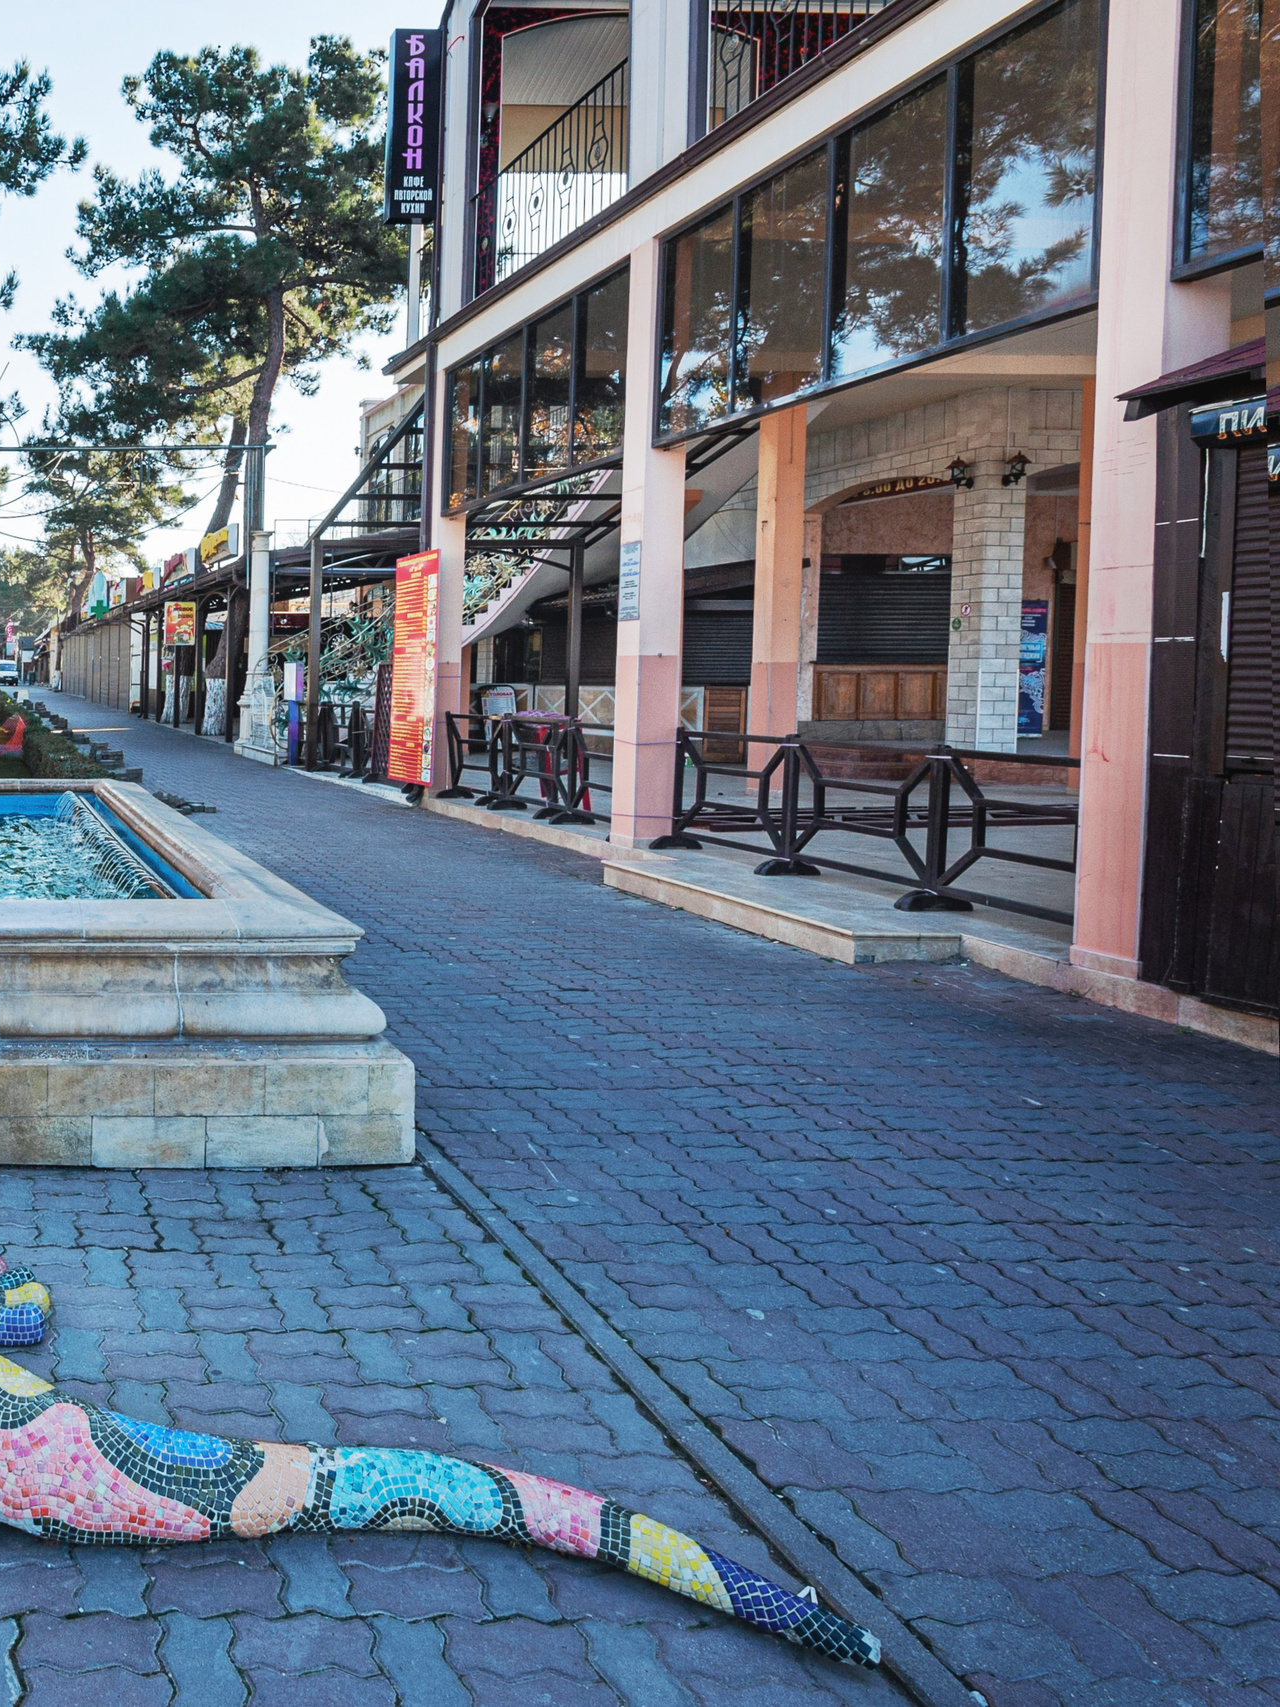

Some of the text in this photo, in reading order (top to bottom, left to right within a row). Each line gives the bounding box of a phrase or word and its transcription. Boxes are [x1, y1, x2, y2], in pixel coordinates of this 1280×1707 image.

[401, 34, 426, 170] БАЛКОН
[403, 176, 425, 188] КАФЕ
[394, 188, 433, 201] АВТОРСКОЙ
[400, 202, 425, 214] КУХНИ
